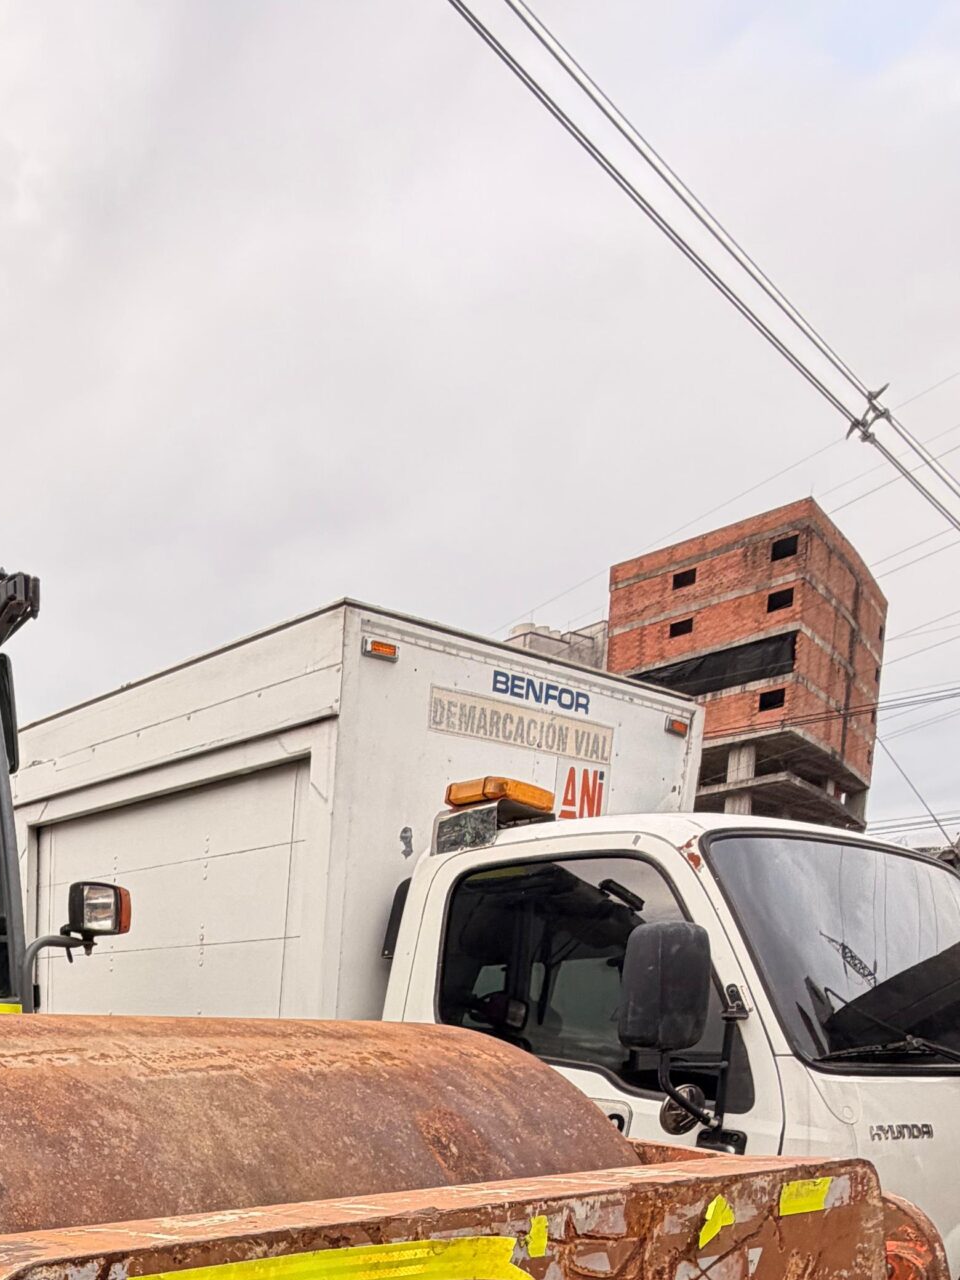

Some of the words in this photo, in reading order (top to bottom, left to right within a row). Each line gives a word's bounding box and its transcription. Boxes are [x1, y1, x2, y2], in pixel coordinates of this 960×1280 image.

[492, 669, 591, 715] BENFOR
[431, 695, 569, 752] DEMARCACIÓN
[574, 729, 609, 762] VIAL
[869, 1123, 934, 1142] HYUNDAI
